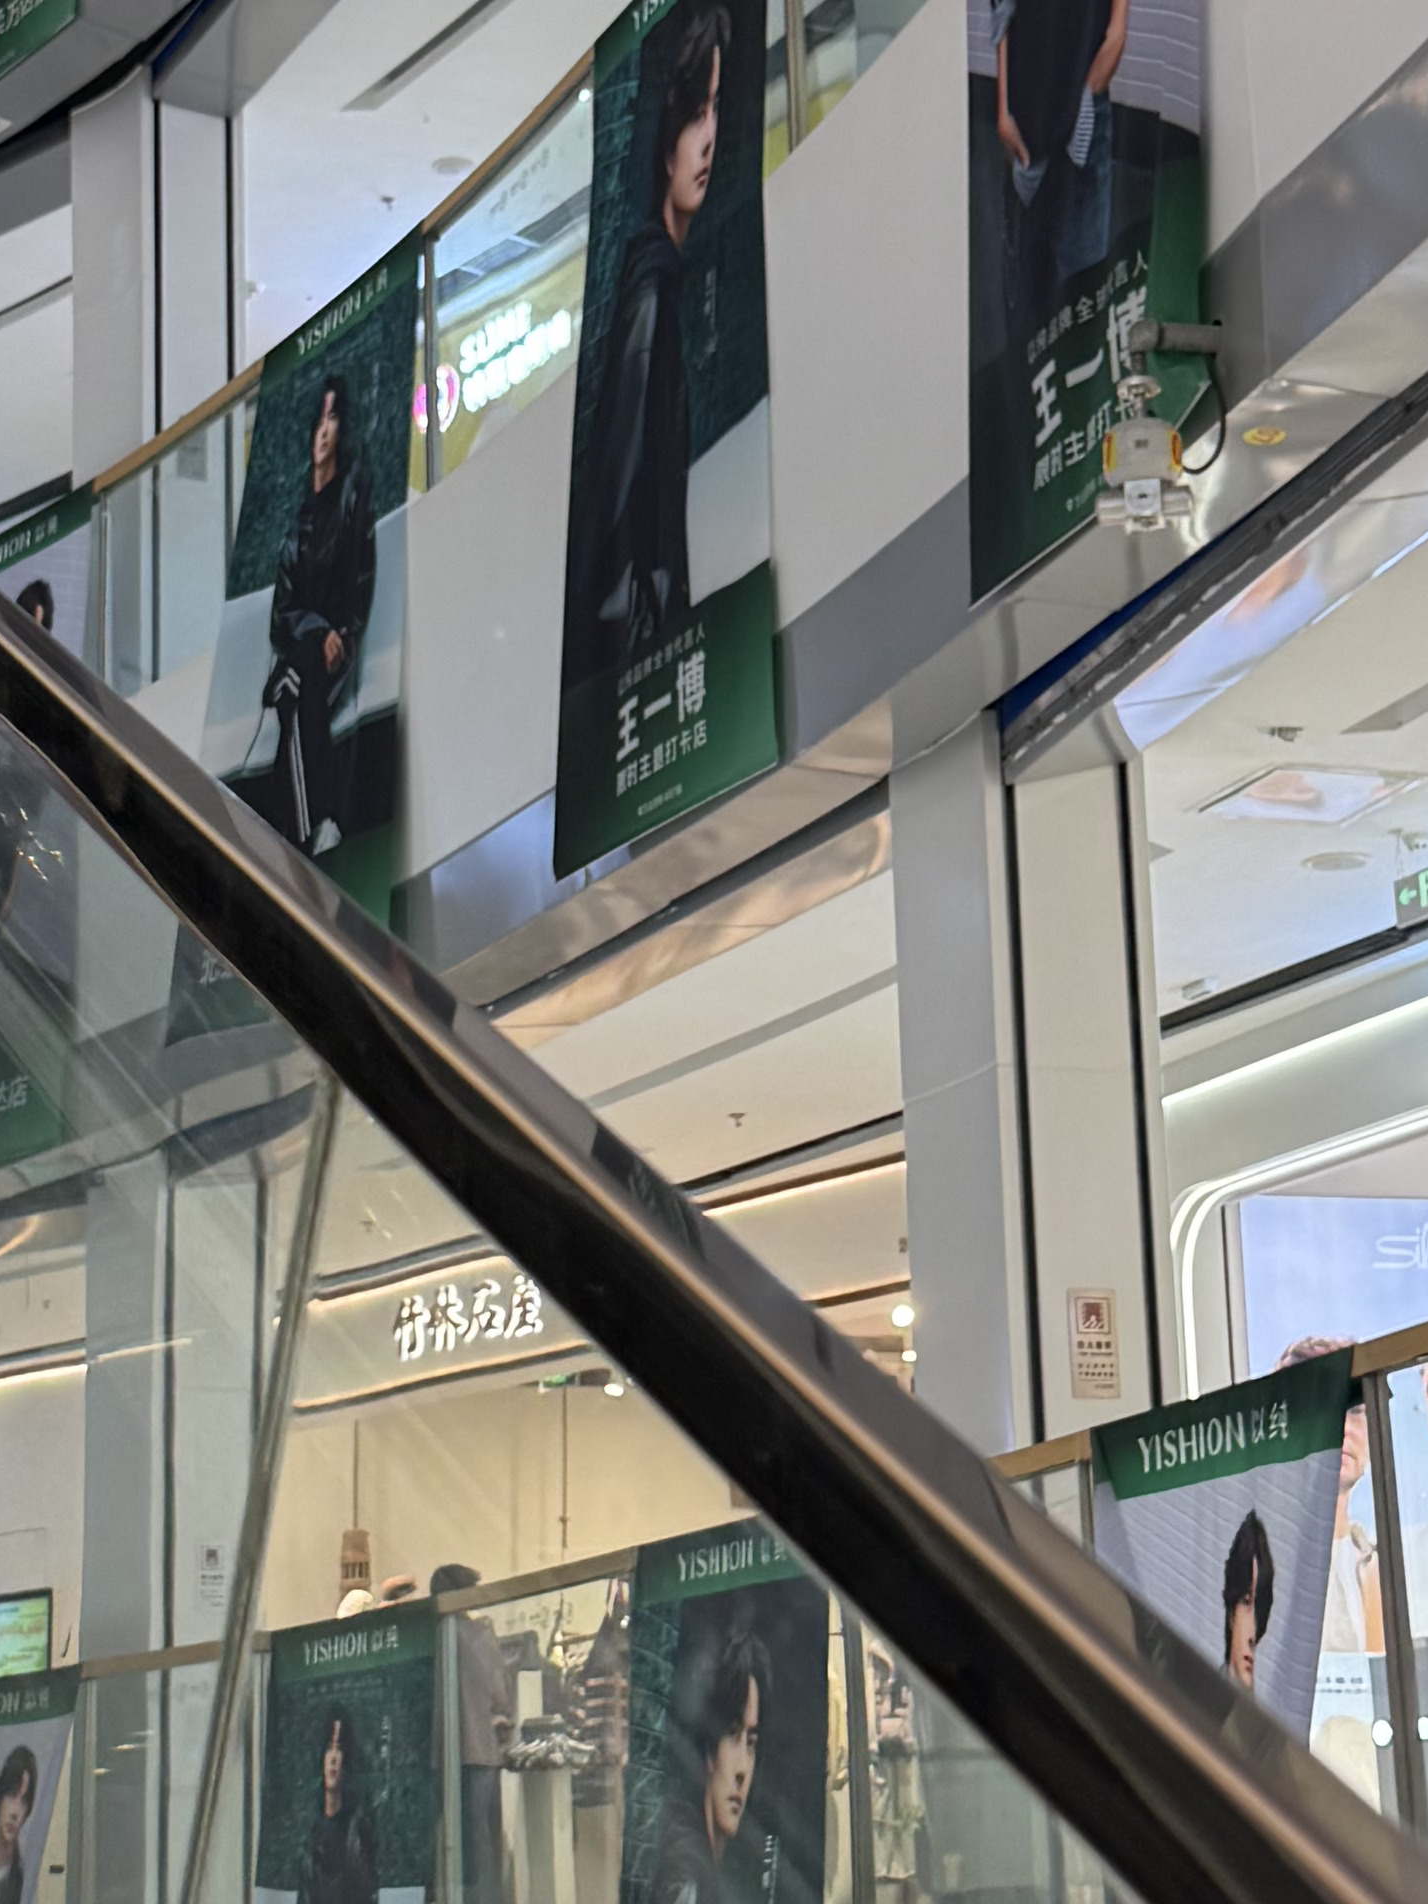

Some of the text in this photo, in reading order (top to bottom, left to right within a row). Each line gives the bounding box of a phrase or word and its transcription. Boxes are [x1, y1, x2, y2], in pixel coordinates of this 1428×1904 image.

[616, 649, 707, 763] 王一博
[1137, 1411, 1247, 1474] YISHION
[677, 1539, 753, 1583] YISHION
[303, 1631, 368, 1666] YISHION
